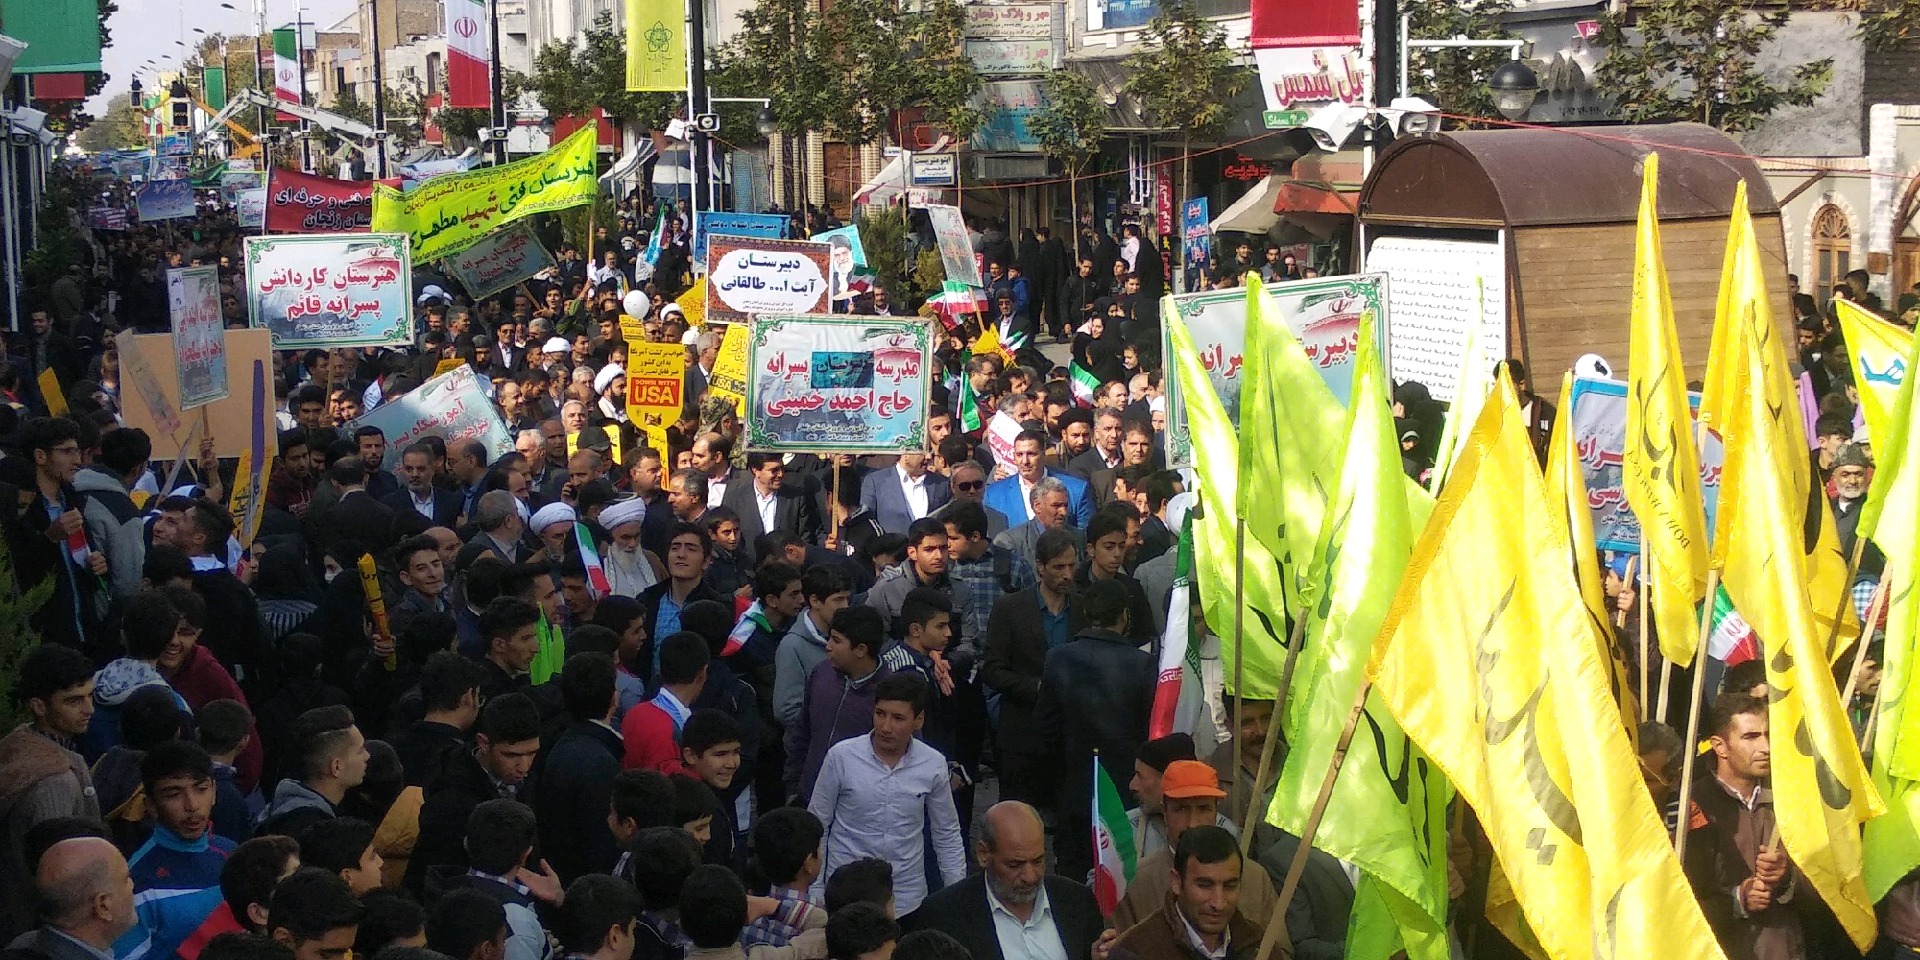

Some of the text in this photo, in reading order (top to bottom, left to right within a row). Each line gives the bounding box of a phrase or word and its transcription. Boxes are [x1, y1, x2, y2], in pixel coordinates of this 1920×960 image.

[971, 7, 1049, 21] مهر و پلاک زنجان
[1032, 48, 1049, 60] مهر
[1274, 49, 1332, 107] شمس
[327, 196, 337, 209] و
[410, 157, 595, 250] هنرستان فنی شهید مطهری
[303, 208, 342, 231] زنجان
[750, 221, 778, 231] دبیرستان
[738, 252, 801, 273] دبیرستان
[333, 267, 396, 290] هنرستان
[720, 275, 766, 292] طالقانی
[791, 278, 817, 297] آیت
[286, 294, 382, 322] پسرانه قائم
[1298, 330, 1360, 368] دبیرس
[766, 350, 809, 382] پسرانه
[876, 358, 919, 383] مدرسه
[634, 385, 675, 405] USA
[767, 387, 913, 418] حاج احمد خمینی
[412, 396, 466, 436] آموزشگاه
[446, 418, 490, 446] تیزهوشا
